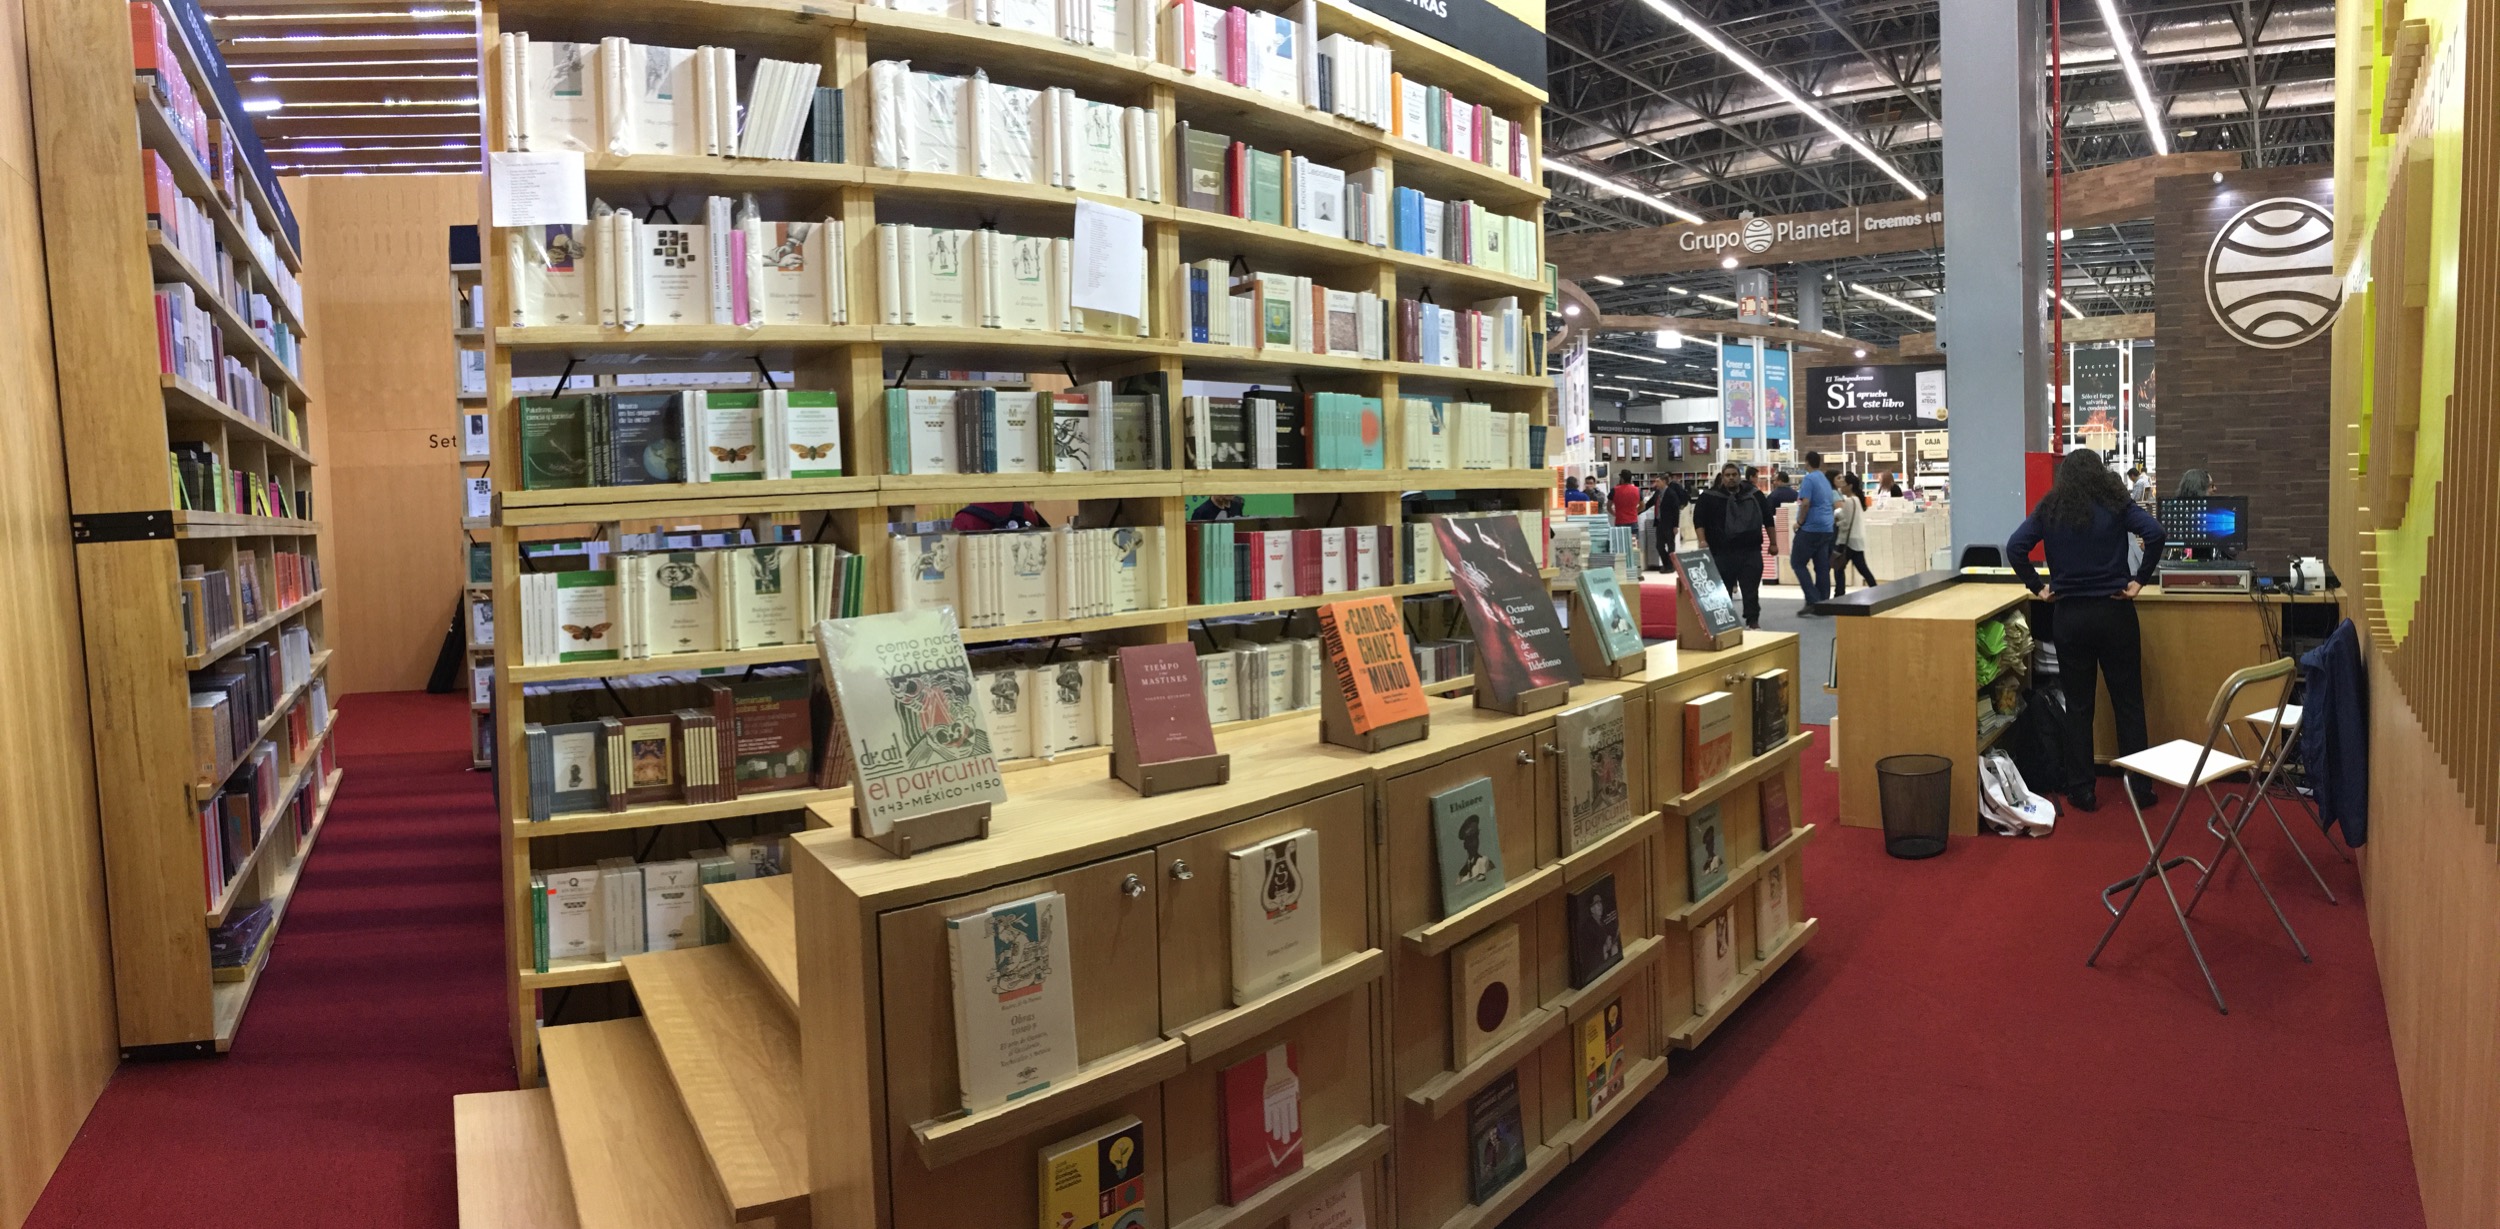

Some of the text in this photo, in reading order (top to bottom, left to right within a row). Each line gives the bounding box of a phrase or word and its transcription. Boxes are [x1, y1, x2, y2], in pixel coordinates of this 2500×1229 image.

[1679, 231, 1740, 254] Grupo
[1777, 218, 1851, 242] Planeta
[1864, 213, 1922, 231] Creemos
[1834, 374, 1874, 383] Todopoderoso
[1827, 382, 1857, 410] Sí
[1857, 390, 1887, 400] aprueba
[1862, 398, 1905, 408] este libro
[429, 434, 457, 449] Set
[1506, 602, 1535, 615] Octavio
[1348, 604, 1393, 636] CARLOS
[1510, 615, 1525, 626] Paz
[1515, 626, 1551, 640] Nocturno
[876, 633, 959, 655] como nace
[1357, 632, 1402, 665] CHAVEZ
[1520, 640, 1530, 651] de
[893, 647, 939, 663] crece
[944, 643, 963, 655] un
[1320, 612, 1360, 702] CARLOS CHAVEZ
[1523, 651, 1540, 661] San
[1144, 662, 1180, 672] TIEMPO
[1528, 658, 1562, 672] Ildefonso
[1141, 674, 1188, 686] MASTINES
[1367, 661, 1411, 695] MUNDO
[868, 776, 890, 801] el
[1449, 795, 1484, 813] Elsinore
[1011, 1014, 1035, 1026] Obras
